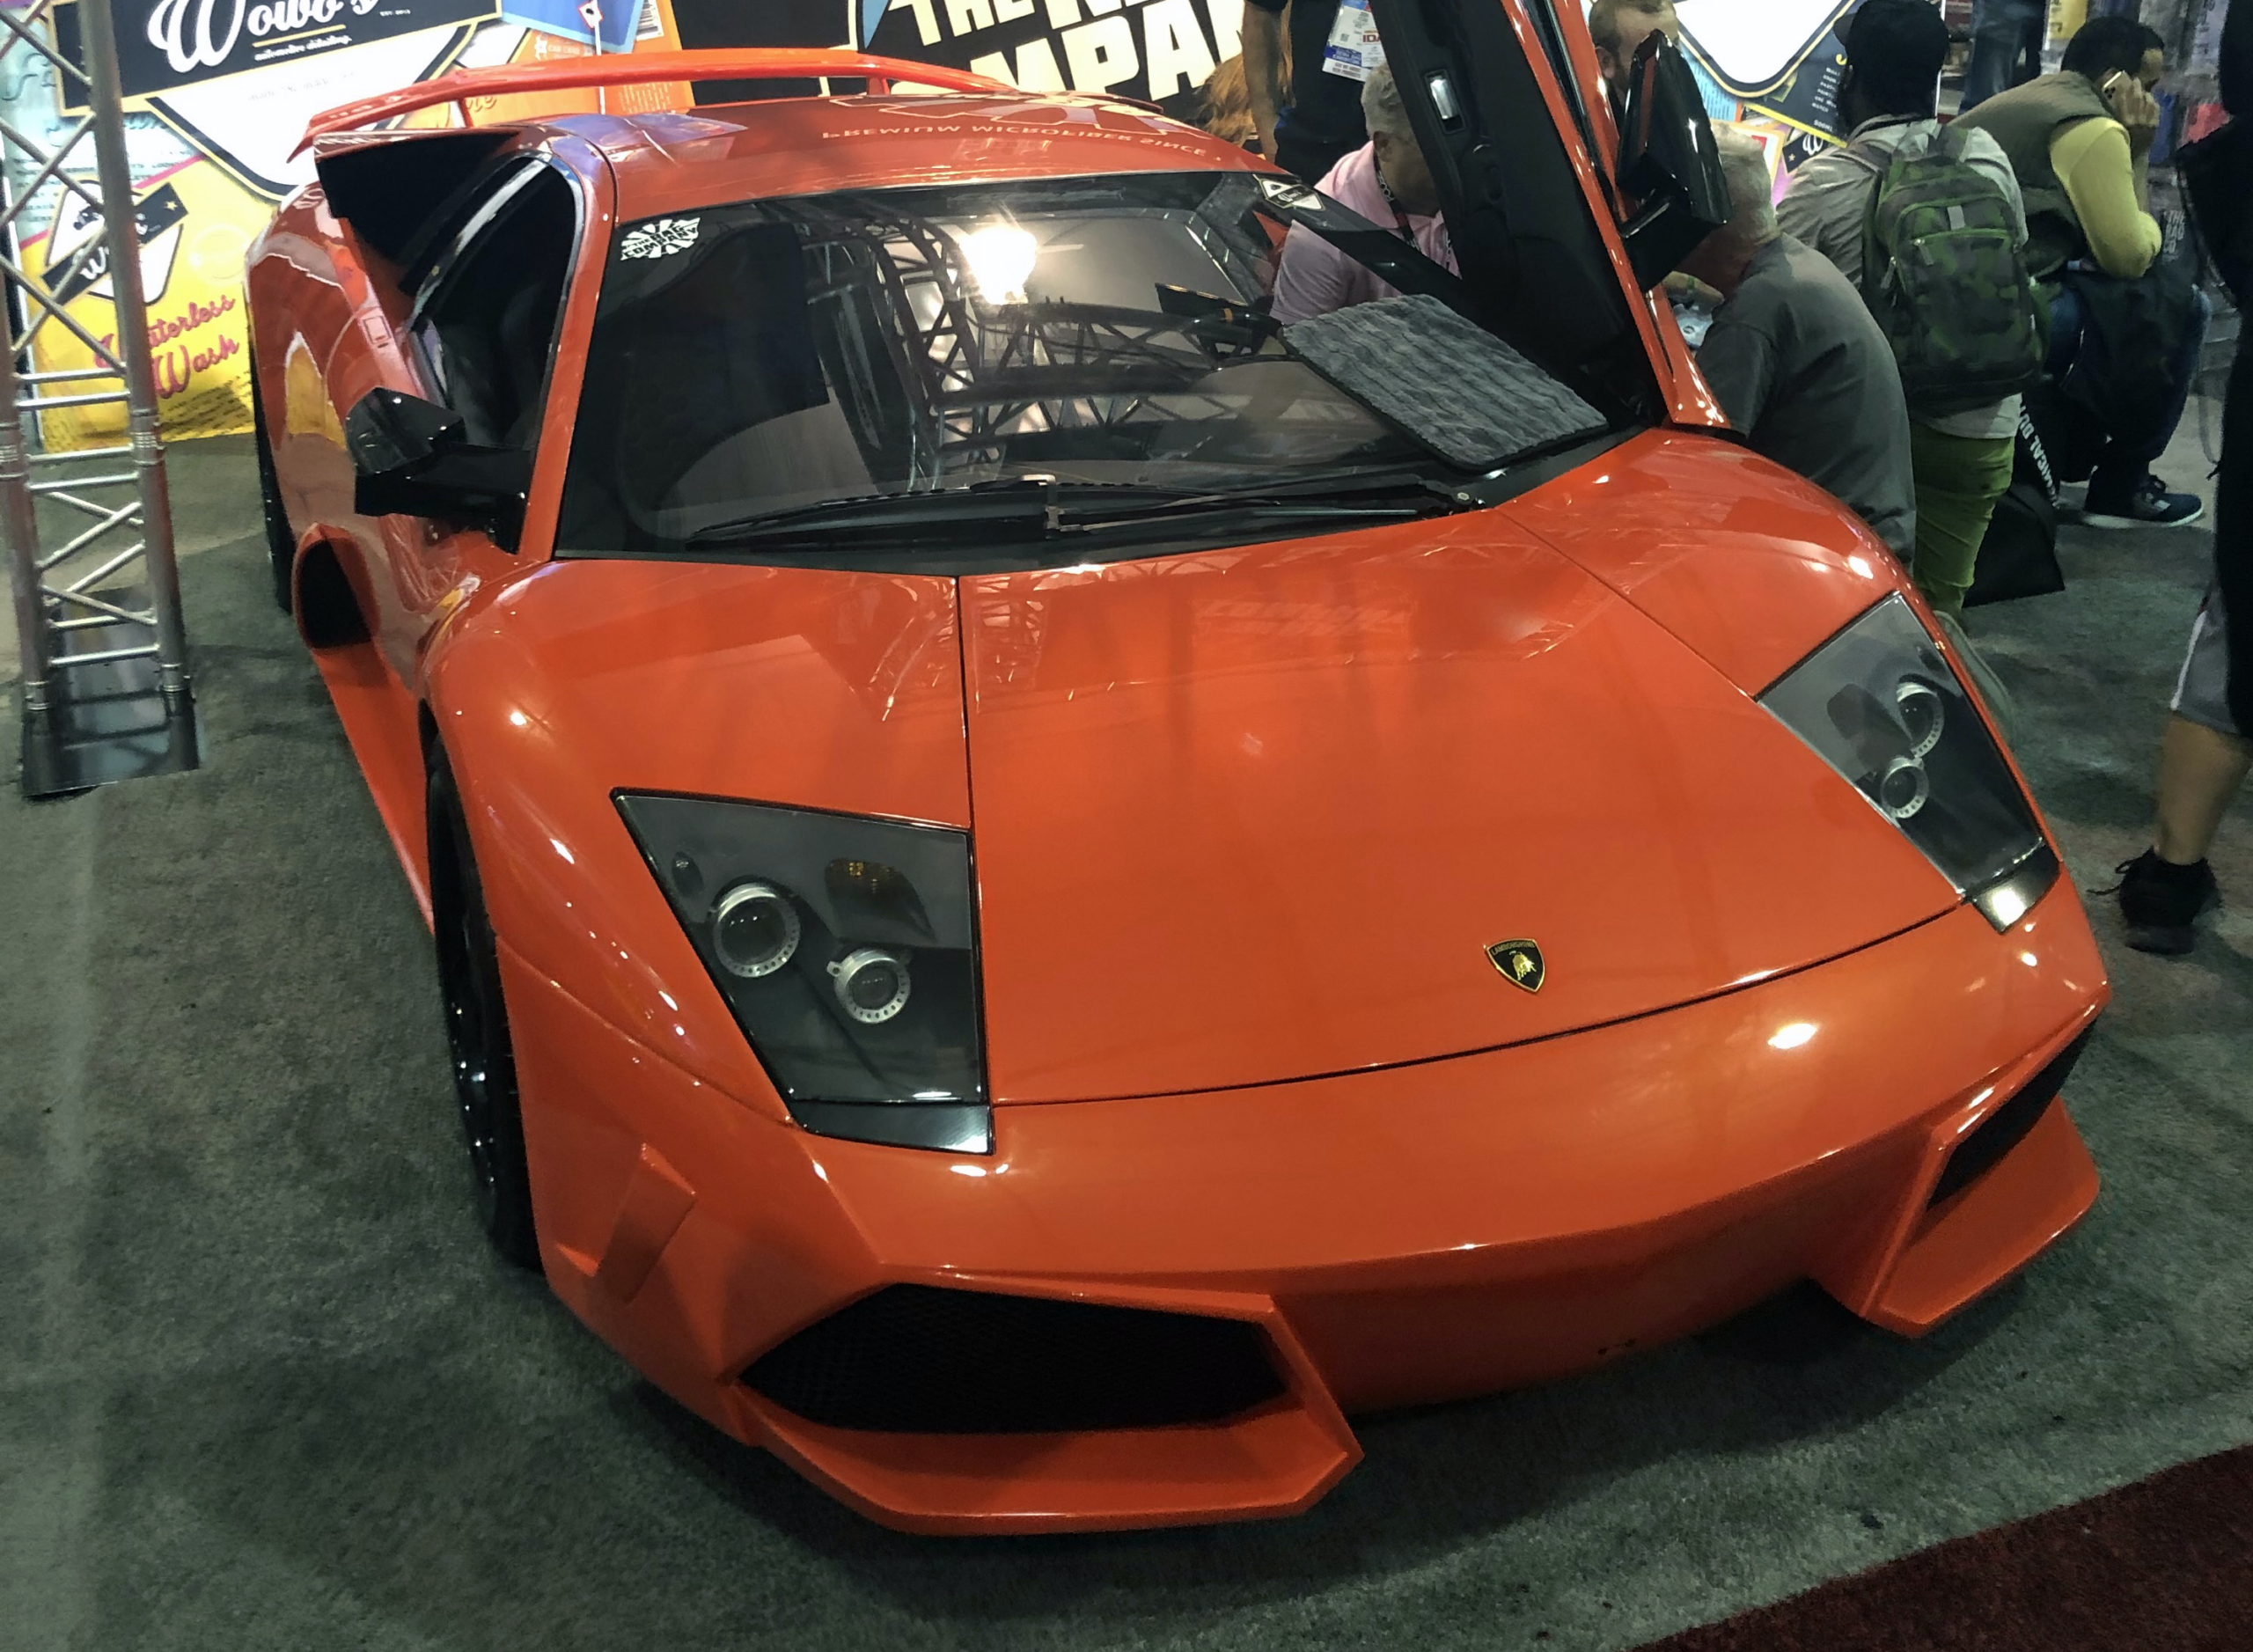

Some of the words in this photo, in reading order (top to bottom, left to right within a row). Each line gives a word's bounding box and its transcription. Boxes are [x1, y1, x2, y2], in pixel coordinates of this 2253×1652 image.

[148, 0, 379, 73] Wowo
[1362, 34, 1380, 43] ID
[623, 227, 697, 257] COMPANY
[634, 239, 650, 247] THE
[151, 334, 240, 399] Wash
